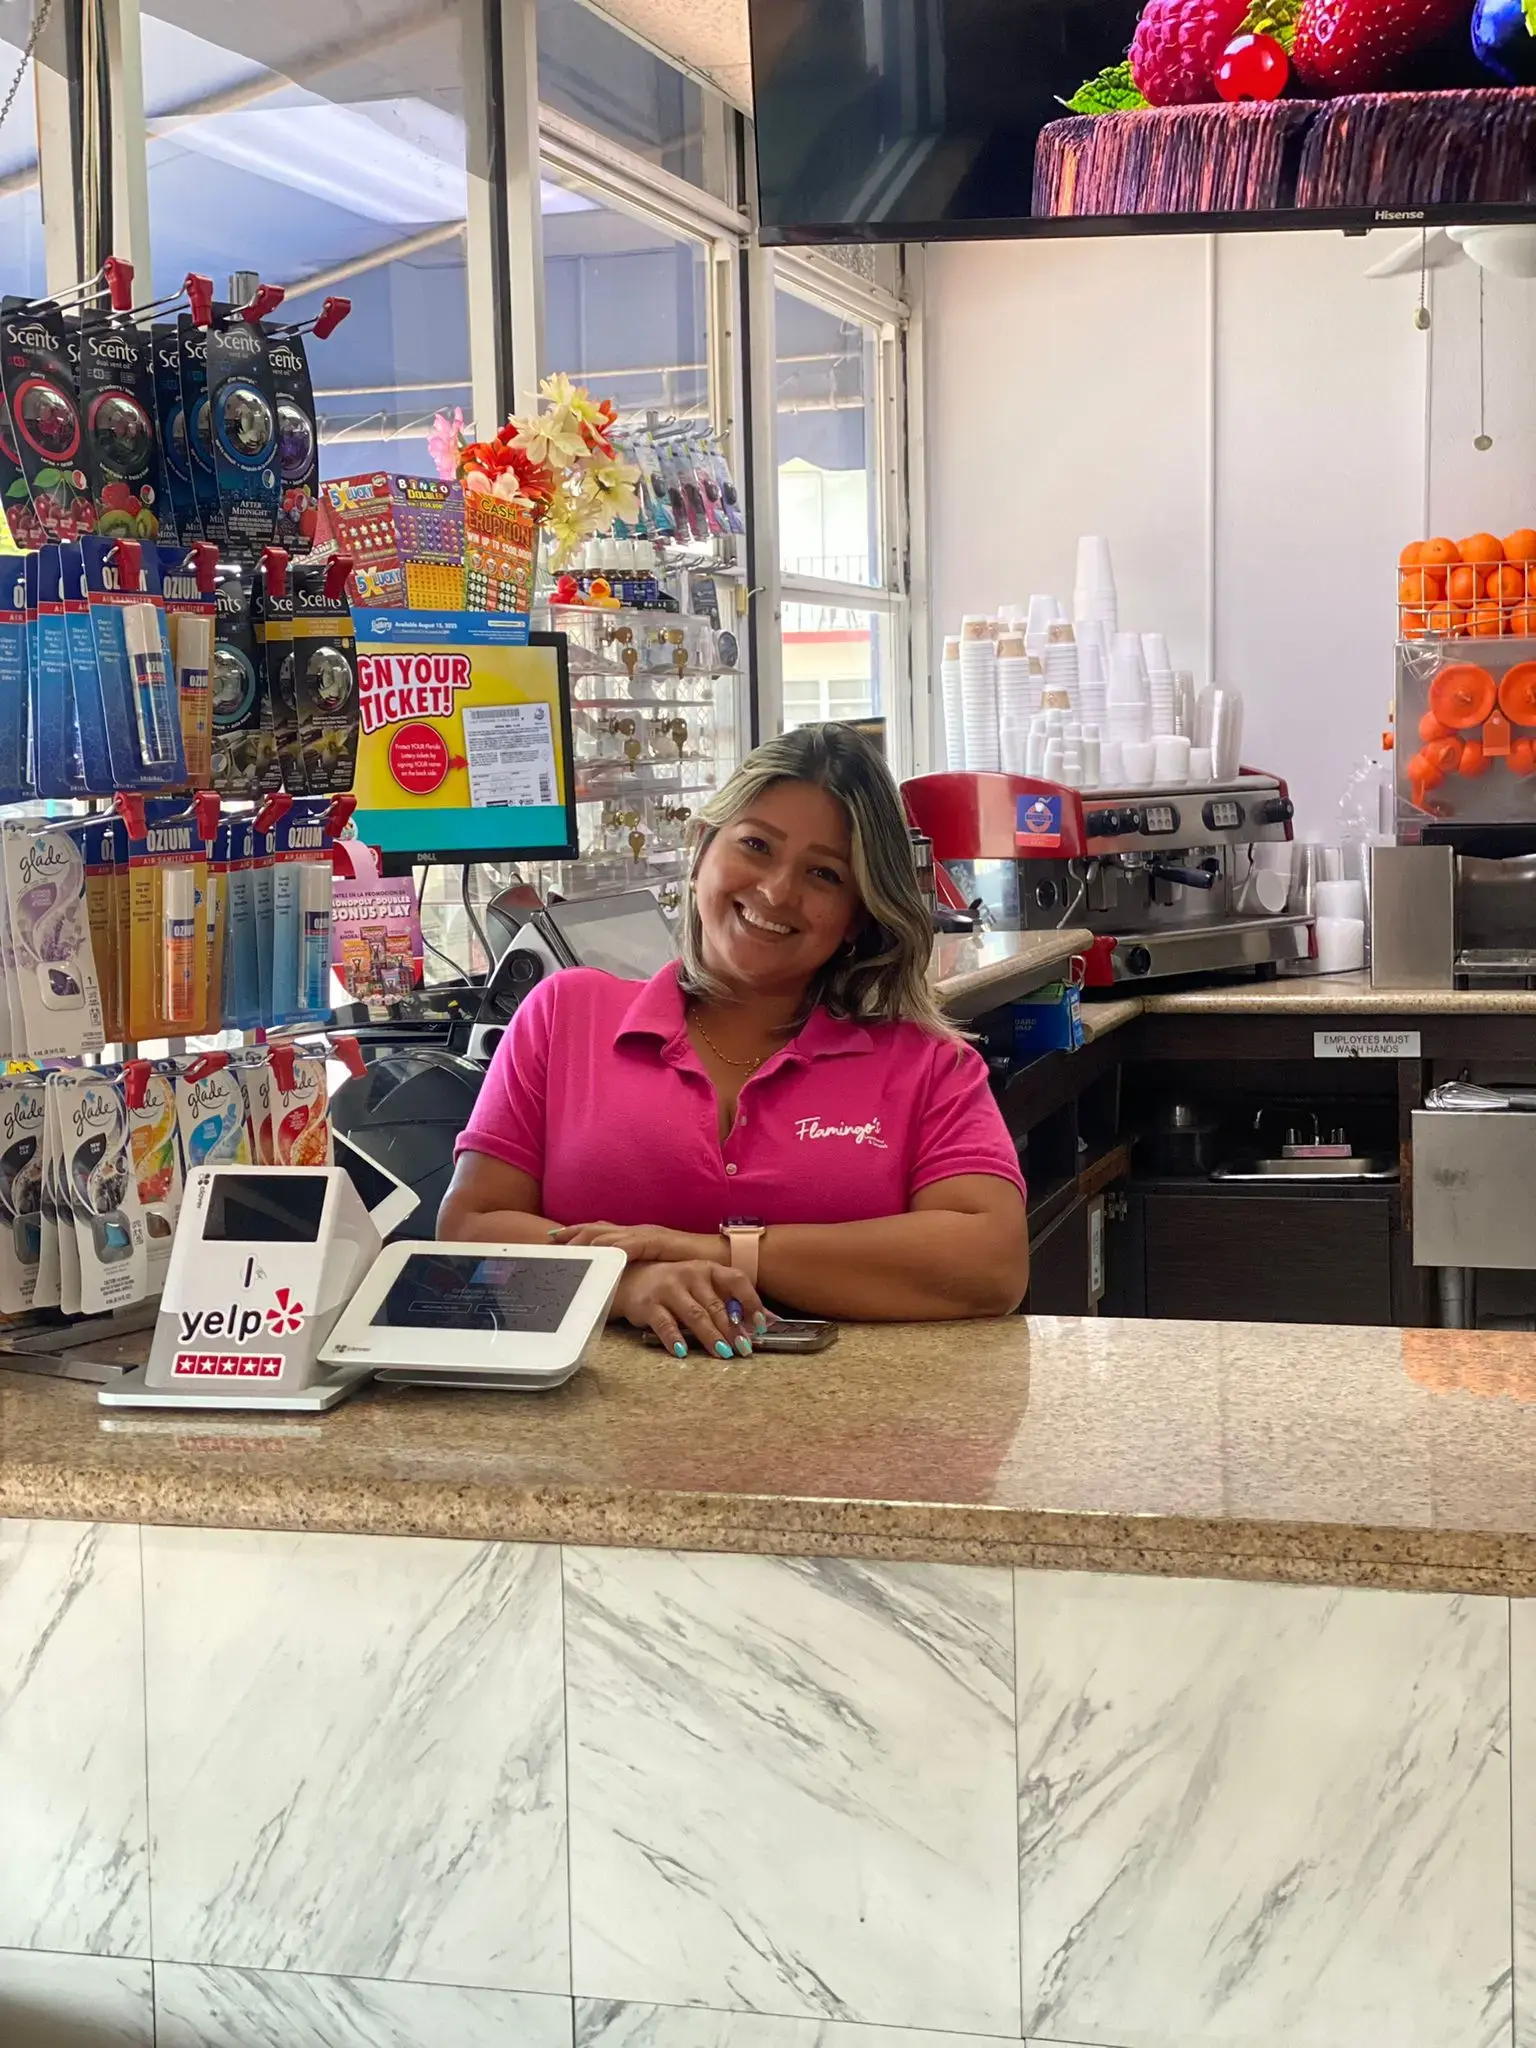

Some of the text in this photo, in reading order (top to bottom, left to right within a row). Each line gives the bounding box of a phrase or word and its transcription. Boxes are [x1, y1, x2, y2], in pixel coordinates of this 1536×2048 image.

[1375, 210, 1424, 220] Hisense
[7, 323, 60, 352] Scents
[88, 336, 139, 363] Scents
[214, 328, 262, 355] Scents
[268, 345, 303, 372] cents
[347, 484, 374, 501] LUCKY
[398, 478, 449, 494] BINGO
[232, 506, 268, 517] MIDNIGHT
[481, 499, 516, 520] CASH
[467, 507, 532, 547] ERUPTION
[270, 596, 293, 612] Sce
[357, 656, 468, 693] GN YOUR
[360, 685, 452, 732] TICKET!
[146, 828, 191, 852] OZIUM
[288, 827, 322, 849] OZIUM
[20, 845, 69, 884] glade
[417, 853, 437, 861] DELL
[380, 904, 411, 918] PLAY
[1324, 1035, 1409, 1044] EMPLOYEES MUST
[1336, 1045, 1399, 1054] WASH HANDS
[188, 1080, 230, 1119] glade
[4, 1099, 45, 1139] glade
[73, 1096, 117, 1137] glade
[245, 1256, 254, 1288] I
[181, 1304, 262, 1341] yelp
